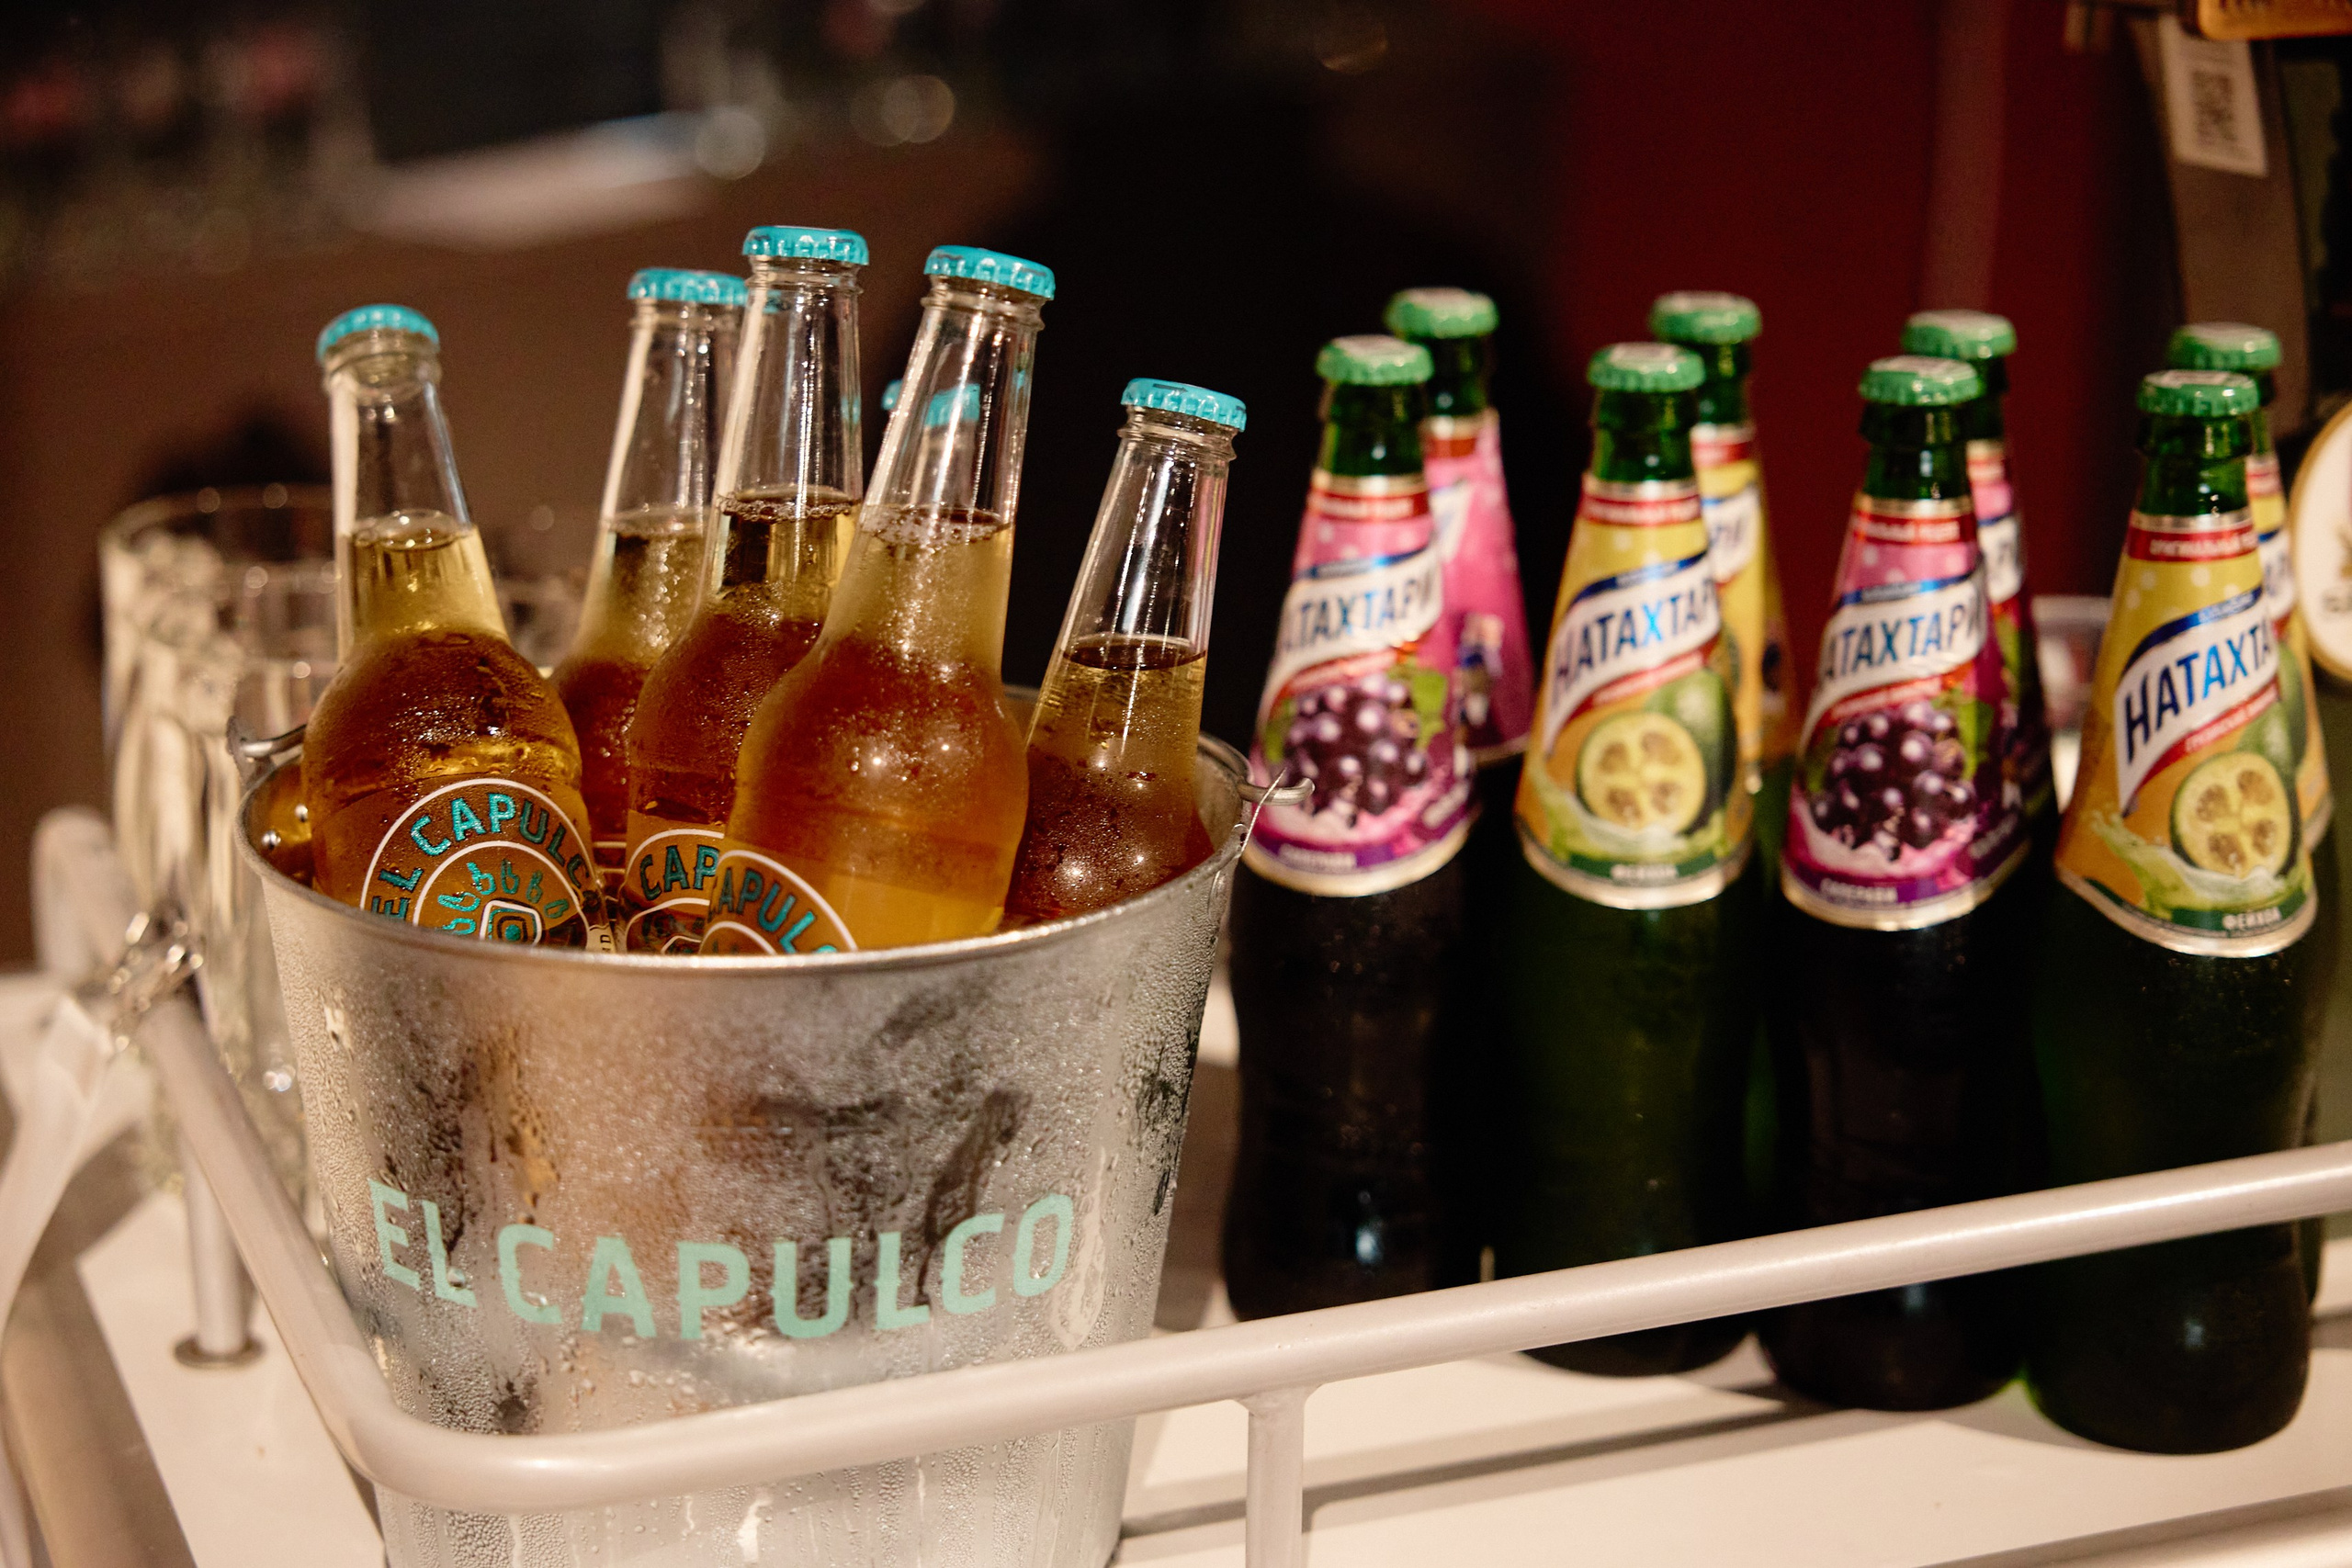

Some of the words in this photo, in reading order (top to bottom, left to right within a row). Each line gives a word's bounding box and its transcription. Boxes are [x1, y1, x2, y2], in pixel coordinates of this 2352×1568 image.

[1552, 579, 1716, 707] НАТАХТАР
[2124, 618, 2271, 765] НАТАХТА
[370, 865, 424, 922] EL
[639, 844, 720, 901] CAP
[708, 867, 837, 954] APUL
[368, 1179, 478, 1309] EL
[498, 1194, 1073, 1339] CAPULCO
